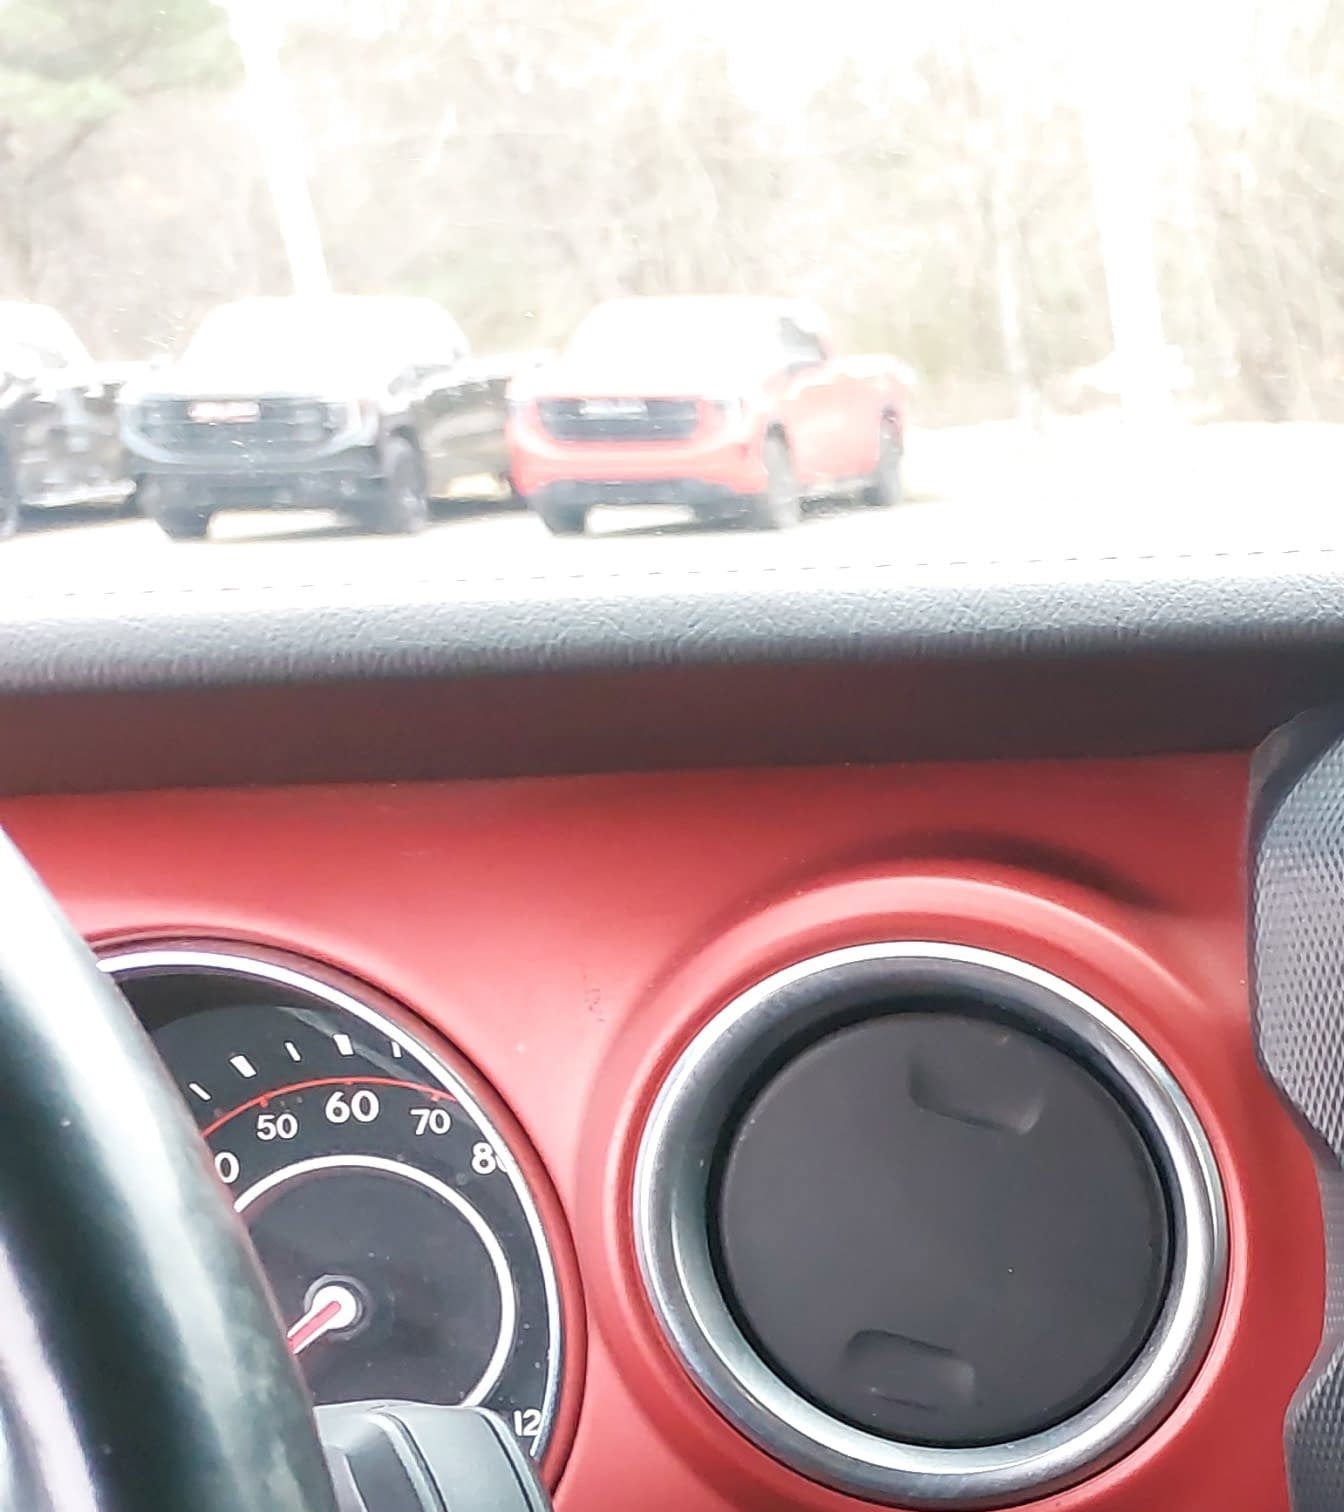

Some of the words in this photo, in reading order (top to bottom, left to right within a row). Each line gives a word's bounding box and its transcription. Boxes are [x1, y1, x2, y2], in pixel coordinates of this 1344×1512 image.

[324, 1090, 379, 1123] 60
[410, 1108, 452, 1135] 70
[256, 1114, 298, 1141] 50
[213, 1151, 239, 1184] 0
[471, 1142, 507, 1174] 8
